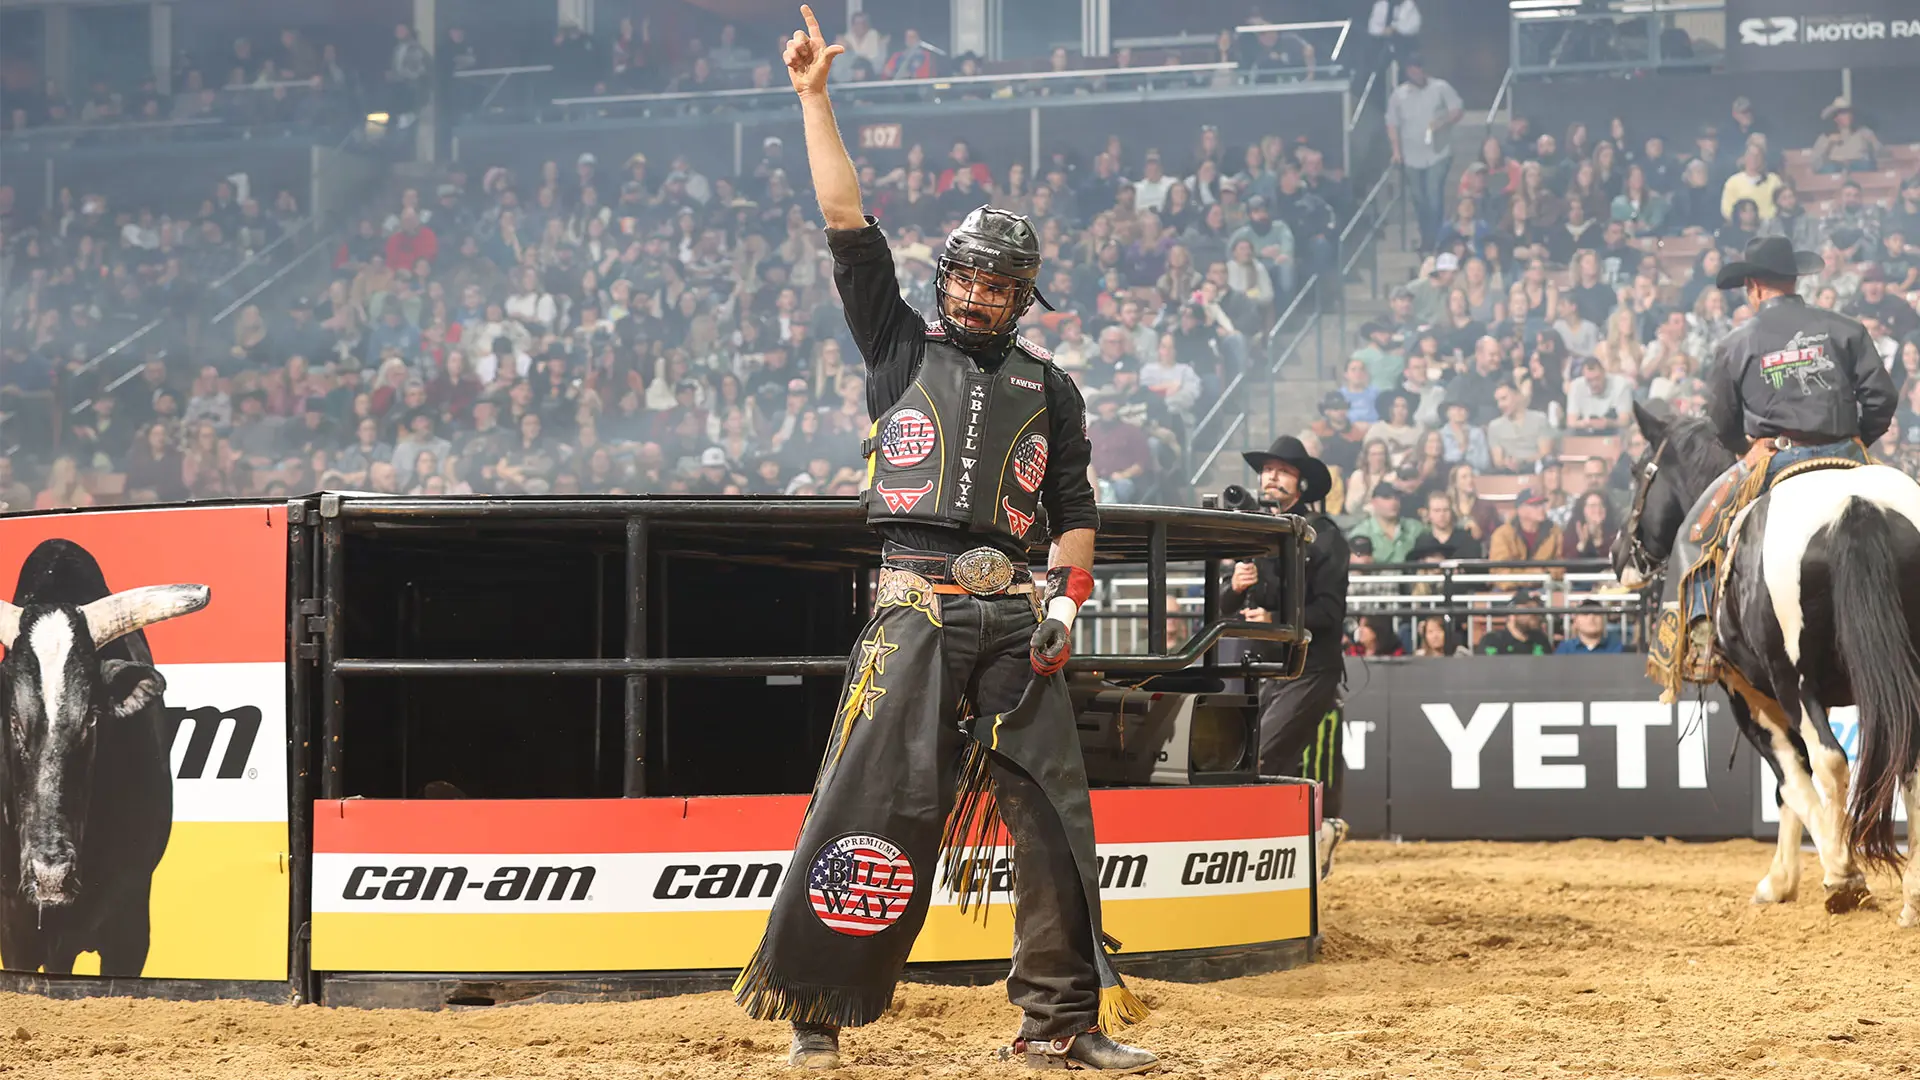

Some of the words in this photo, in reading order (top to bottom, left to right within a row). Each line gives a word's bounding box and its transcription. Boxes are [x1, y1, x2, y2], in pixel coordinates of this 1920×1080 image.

[1806, 22, 1885, 42] MOTOR
[863, 126, 897, 148] 107
[889, 422, 928, 442] BILL
[965, 399, 983, 450] BILL
[887, 441, 927, 456] WAY
[959, 457, 977, 496] WAY
[1420, 701, 1708, 789] YETI
[844, 837, 893, 855] PREMIUM
[653, 863, 783, 899] can
[827, 858, 903, 891] BILL
[1181, 847, 1296, 885] can-am
[342, 866, 596, 901] can-am
[820, 888, 900, 920] WAY
